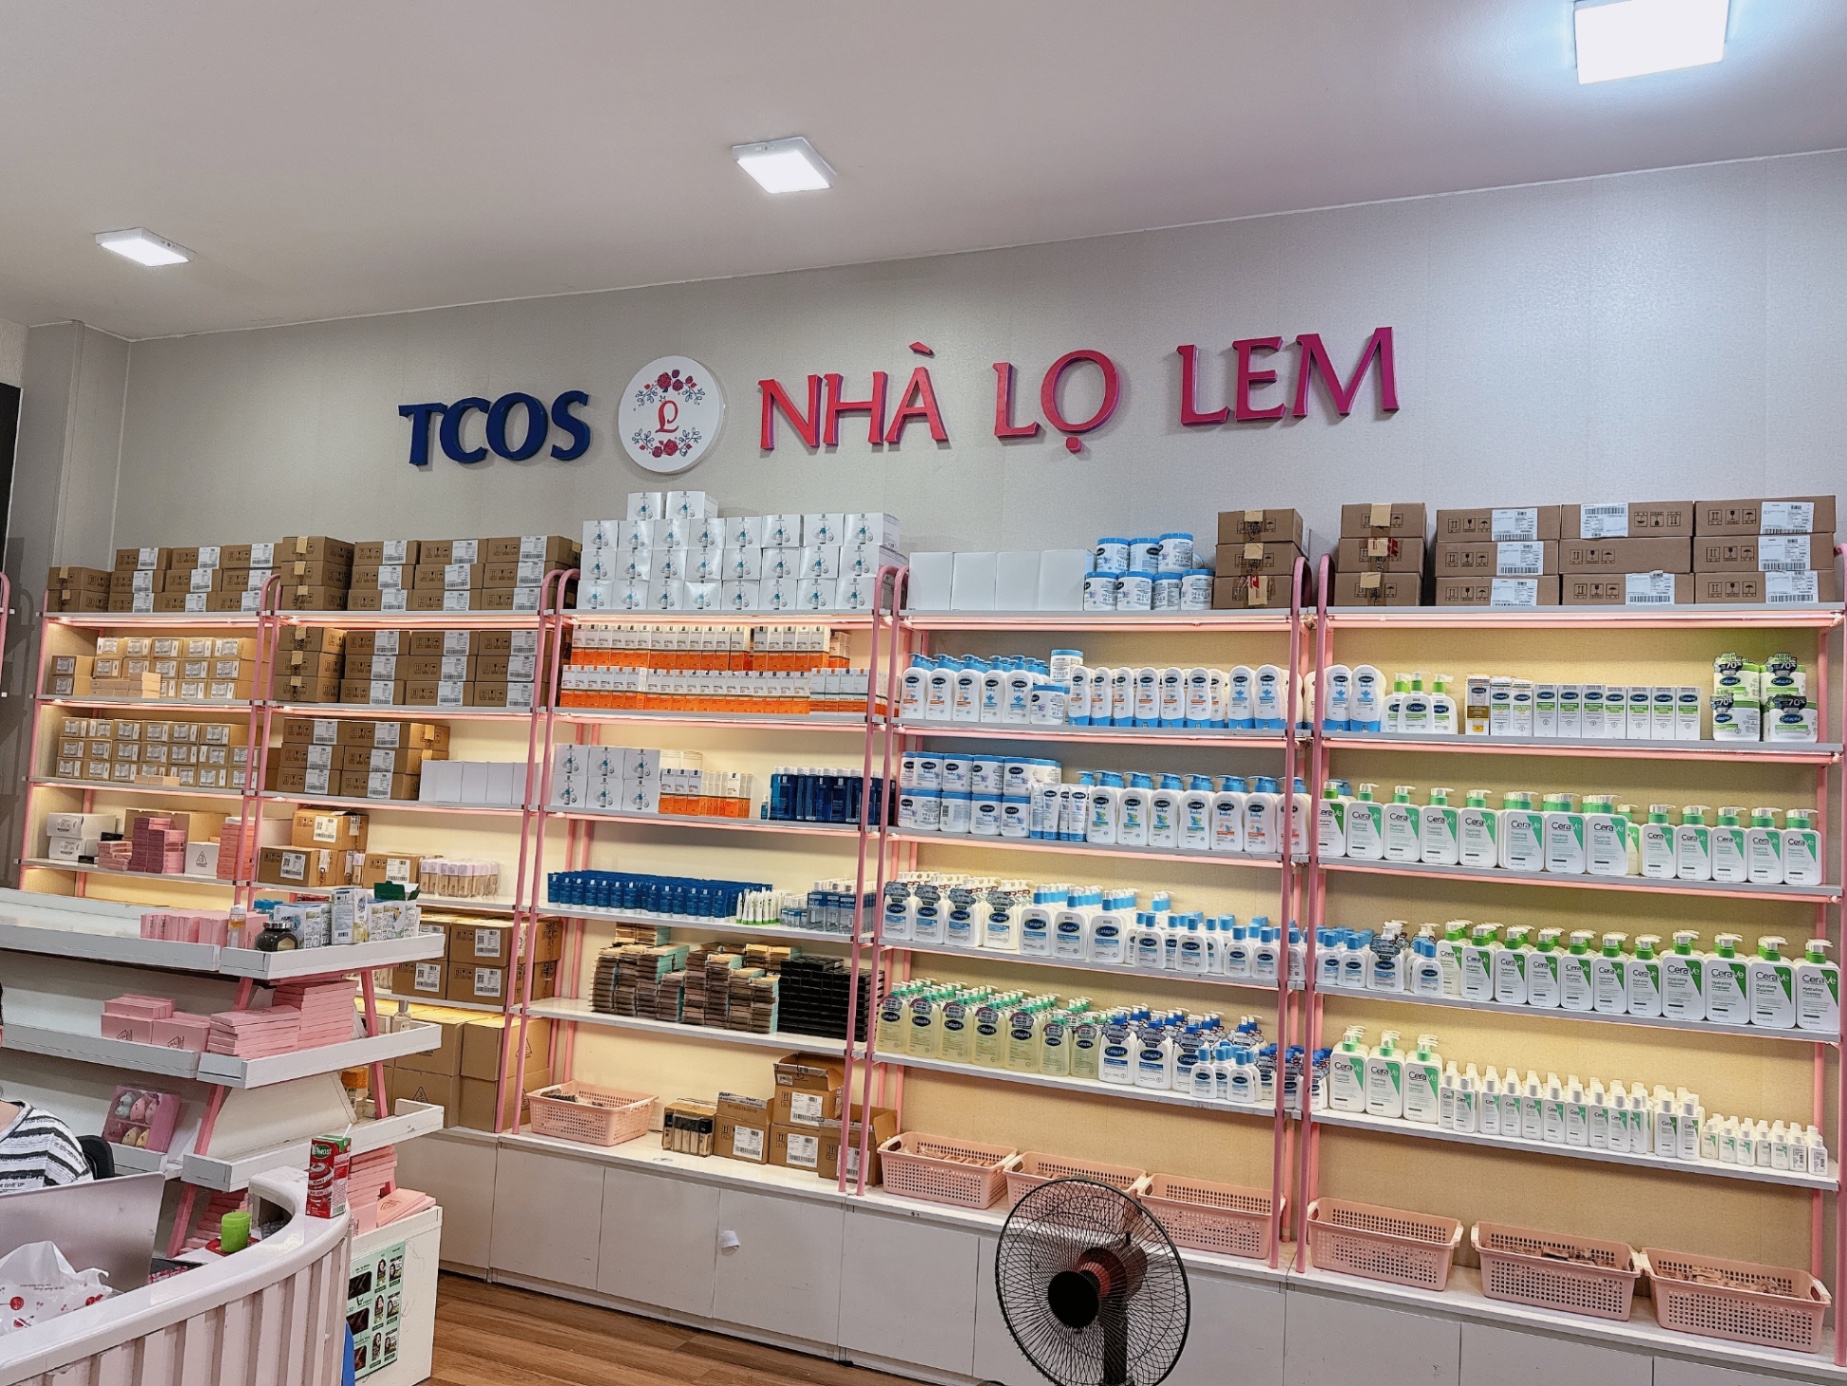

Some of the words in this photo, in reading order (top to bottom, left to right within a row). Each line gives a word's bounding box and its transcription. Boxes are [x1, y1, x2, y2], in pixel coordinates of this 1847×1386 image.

[758, 341, 948, 450] NHÀ
[992, 349, 1121, 452] LỌ
[1176, 326, 1400, 426] LEM
[398, 390, 591, 466] TCOS
[1352, 810, 1380, 820] CeraVe
[1389, 812, 1418, 822] CeraVe
[1426, 814, 1456, 824] CeraVe
[1465, 817, 1495, 828] CeraVe
[1511, 820, 1541, 829] CeraVe
[1551, 821, 1582, 831] CeraVe
[1594, 823, 1624, 832] CeraVe
[1566, 964, 1590, 972] CeraVe
[1667, 965, 1700, 975] CeraVe
[1711, 968, 1744, 978] CeraVe
[1755, 972, 1790, 982] CeraVe
[1802, 974, 1836, 985] CeraVe
[1334, 1062, 1362, 1072] CeraVe
[1371, 1066, 1398, 1076] CeraVe
[1408, 1071, 1437, 1081] CeraVe
